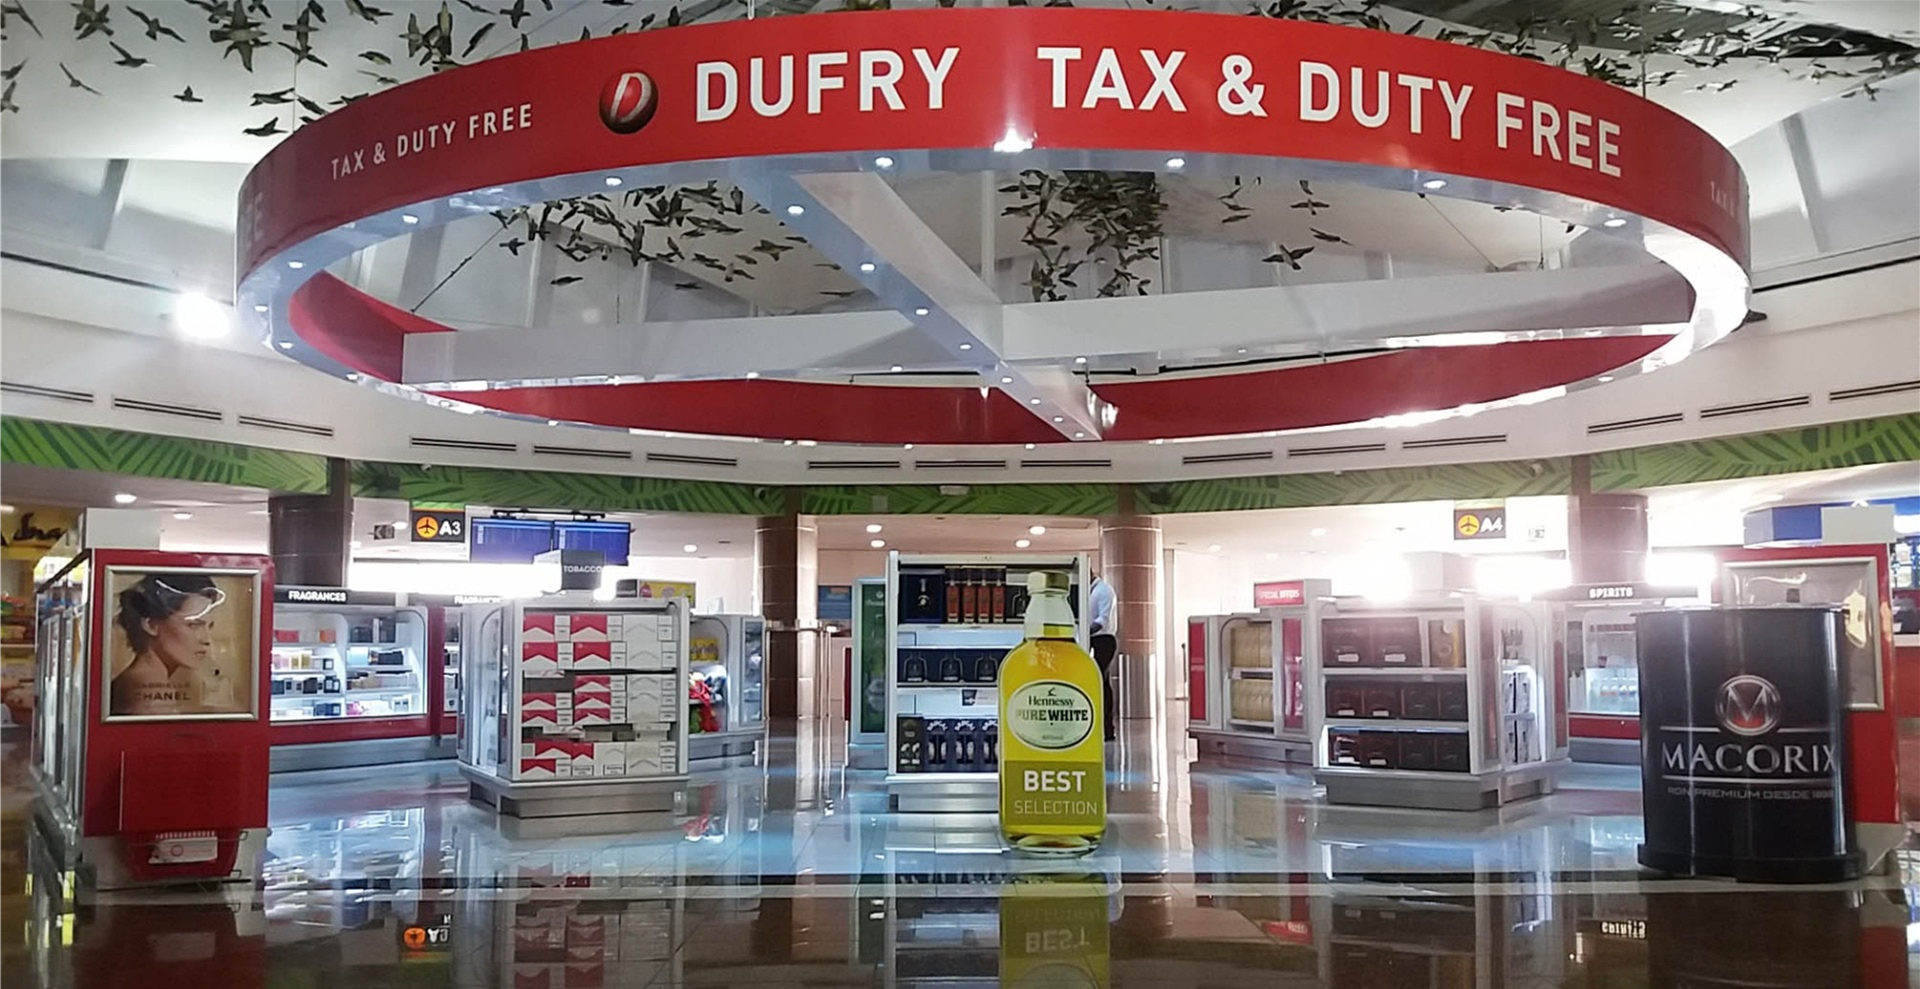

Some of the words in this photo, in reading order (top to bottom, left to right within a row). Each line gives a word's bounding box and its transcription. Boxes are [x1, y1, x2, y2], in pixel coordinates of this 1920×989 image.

[696, 47, 960, 122] DUFRY
[1037, 47, 1187, 112] TAX
[1217, 54, 1268, 117] &
[1300, 61, 1474, 140] DUTY
[1497, 92, 1621, 177] FREE
[331, 149, 364, 181] TAX
[373, 142, 386, 165] &
[397, 121, 456, 158] DUTY
[468, 103, 532, 140] FREE
[439, 520, 461, 536] A3
[1480, 516, 1504, 533] A4
[563, 565, 603, 573] TOBACCO
[288, 590, 347, 602] FRAGRANCES
[1589, 586, 1633, 599] SPIRITS
[1028, 695, 1075, 707] Hennessy
[1048, 709, 1088, 721] WHITE
[1661, 742, 1836, 774] MACORIX
[1023, 769, 1086, 793] BEST
[1667, 786, 1690, 796] RON
[1694, 788, 1760, 800] PREMIUM
[1763, 790, 1809, 800] DESDE
[1014, 799, 1097, 816] SELECTION
